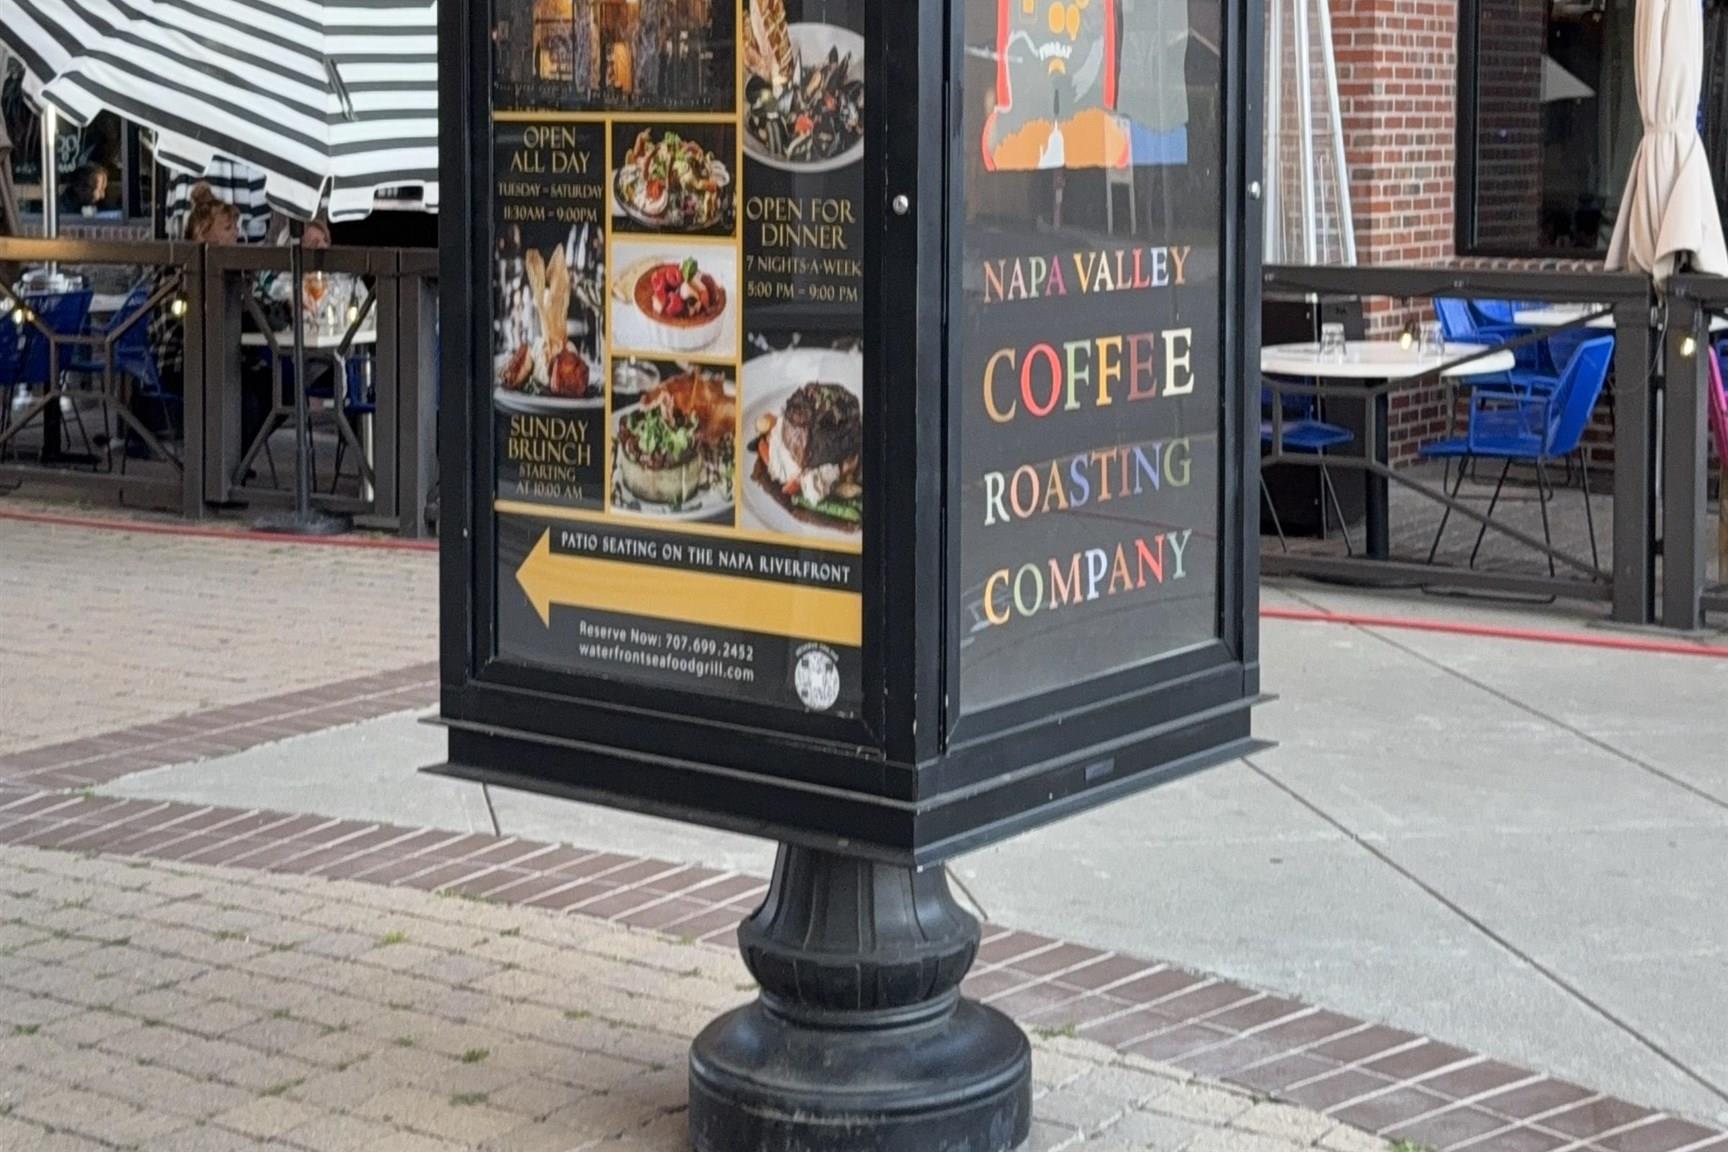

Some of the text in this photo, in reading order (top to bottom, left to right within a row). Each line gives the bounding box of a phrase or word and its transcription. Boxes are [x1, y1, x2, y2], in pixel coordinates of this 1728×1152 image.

[523, 126, 576, 149] OPEN
[510, 149, 591, 175] ALL DAY
[498, 181, 541, 197] TUESDAY
[550, 183, 603, 200] SATURDAY
[746, 196, 856, 225] OPEN FOR
[761, 223, 848, 251] DINNER
[746, 255, 754, 271] 7
[983, 246, 1191, 304] NAPA VALLEY
[776, 281, 794, 300] PM
[839, 285, 858, 303] PM
[983, 327, 1195, 423] COFFEE
[510, 412, 589, 442] SUNDAY
[508, 436, 591, 467] BRUNCH
[519, 462, 576, 482] STARTING
[984, 437, 1192, 527] ROASTING
[516, 479, 530, 496] AT
[564, 483, 583, 500] AM
[561, 531, 851, 585] PATIO SEATING ON THE NAPA RIVERFRONT
[983, 529, 1192, 625] COMPANY
[579, 619, 627, 642] Reserve
[630, 628, 662, 648] Now:
[578, 643, 755, 682] waterfrontseafoodgrill.com
